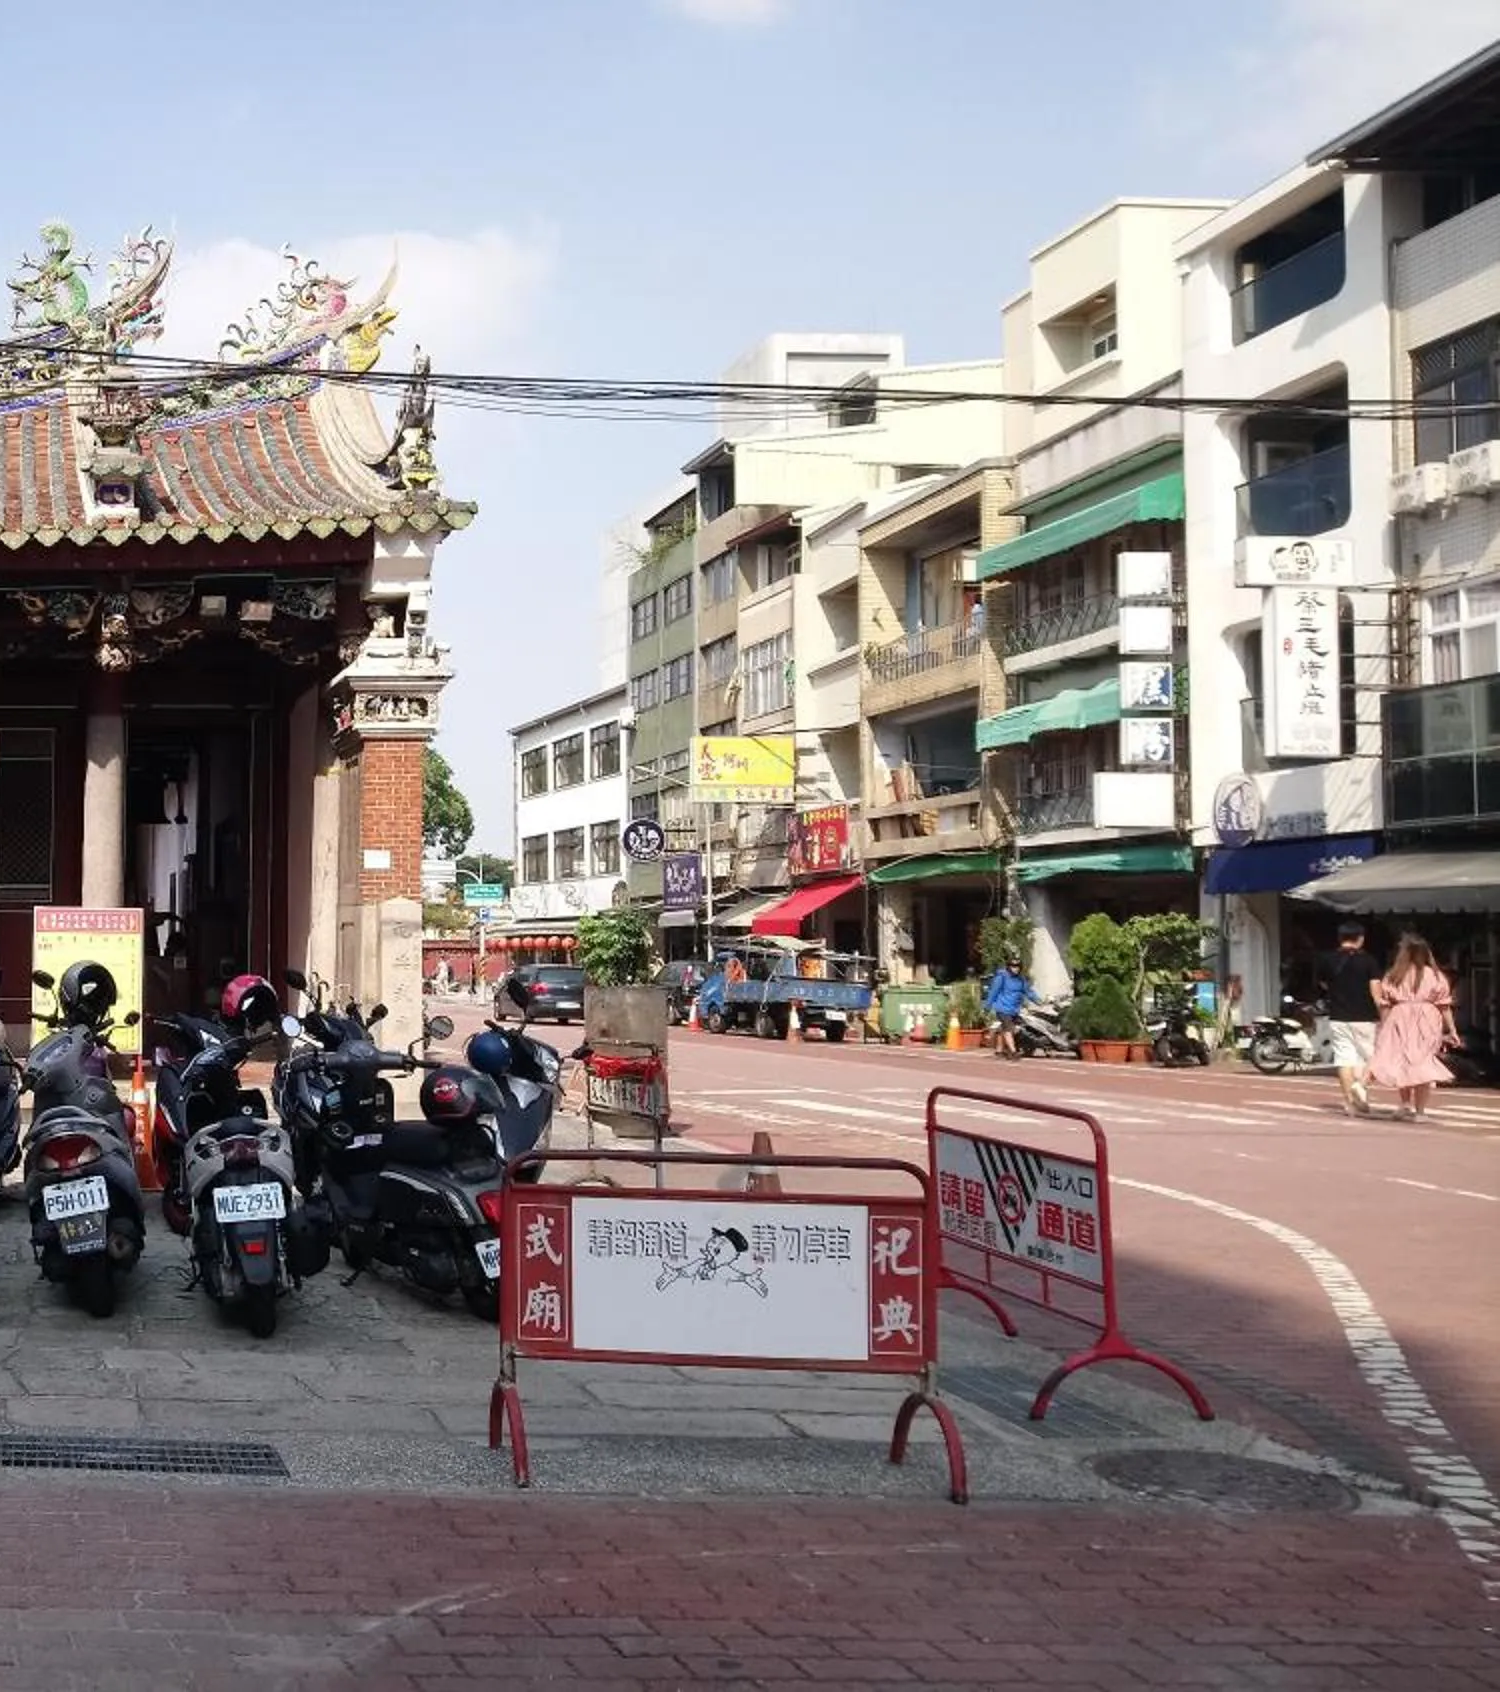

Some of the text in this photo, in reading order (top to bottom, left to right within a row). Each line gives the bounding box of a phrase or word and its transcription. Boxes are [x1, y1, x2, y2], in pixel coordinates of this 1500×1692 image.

[1046, 1168, 1093, 1198] 出入口
[521, 1214, 564, 1334] 武廟
[751, 1223, 852, 1266] 請勿停車
[873, 1226, 920, 1345] 祀典
